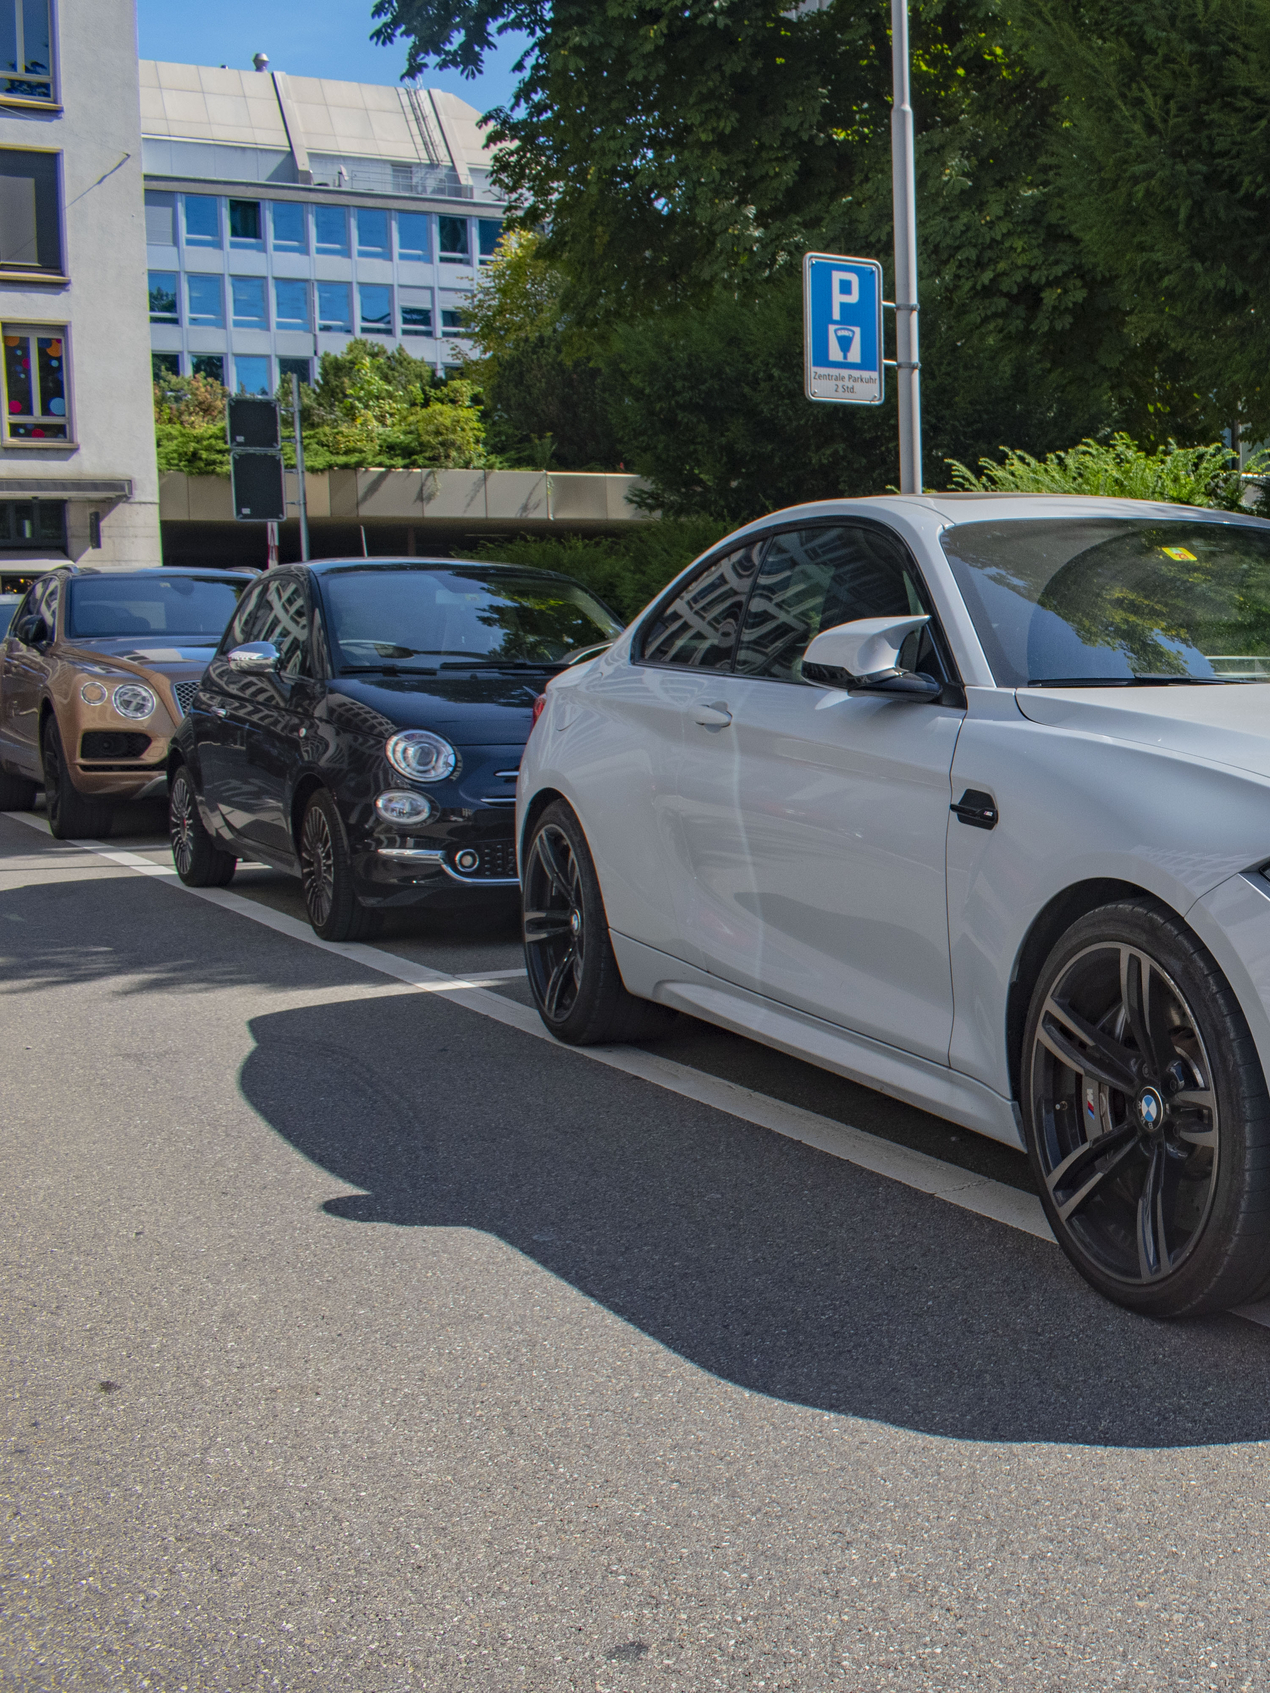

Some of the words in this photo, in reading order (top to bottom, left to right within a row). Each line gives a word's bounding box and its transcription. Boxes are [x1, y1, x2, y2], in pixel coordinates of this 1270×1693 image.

[831, 270, 859, 321] P
[813, 371, 846, 383] Zentrale
[847, 374, 877, 385] Parkuhr
[834, 384, 839, 393] 2
[841, 384, 857, 394] Std.
